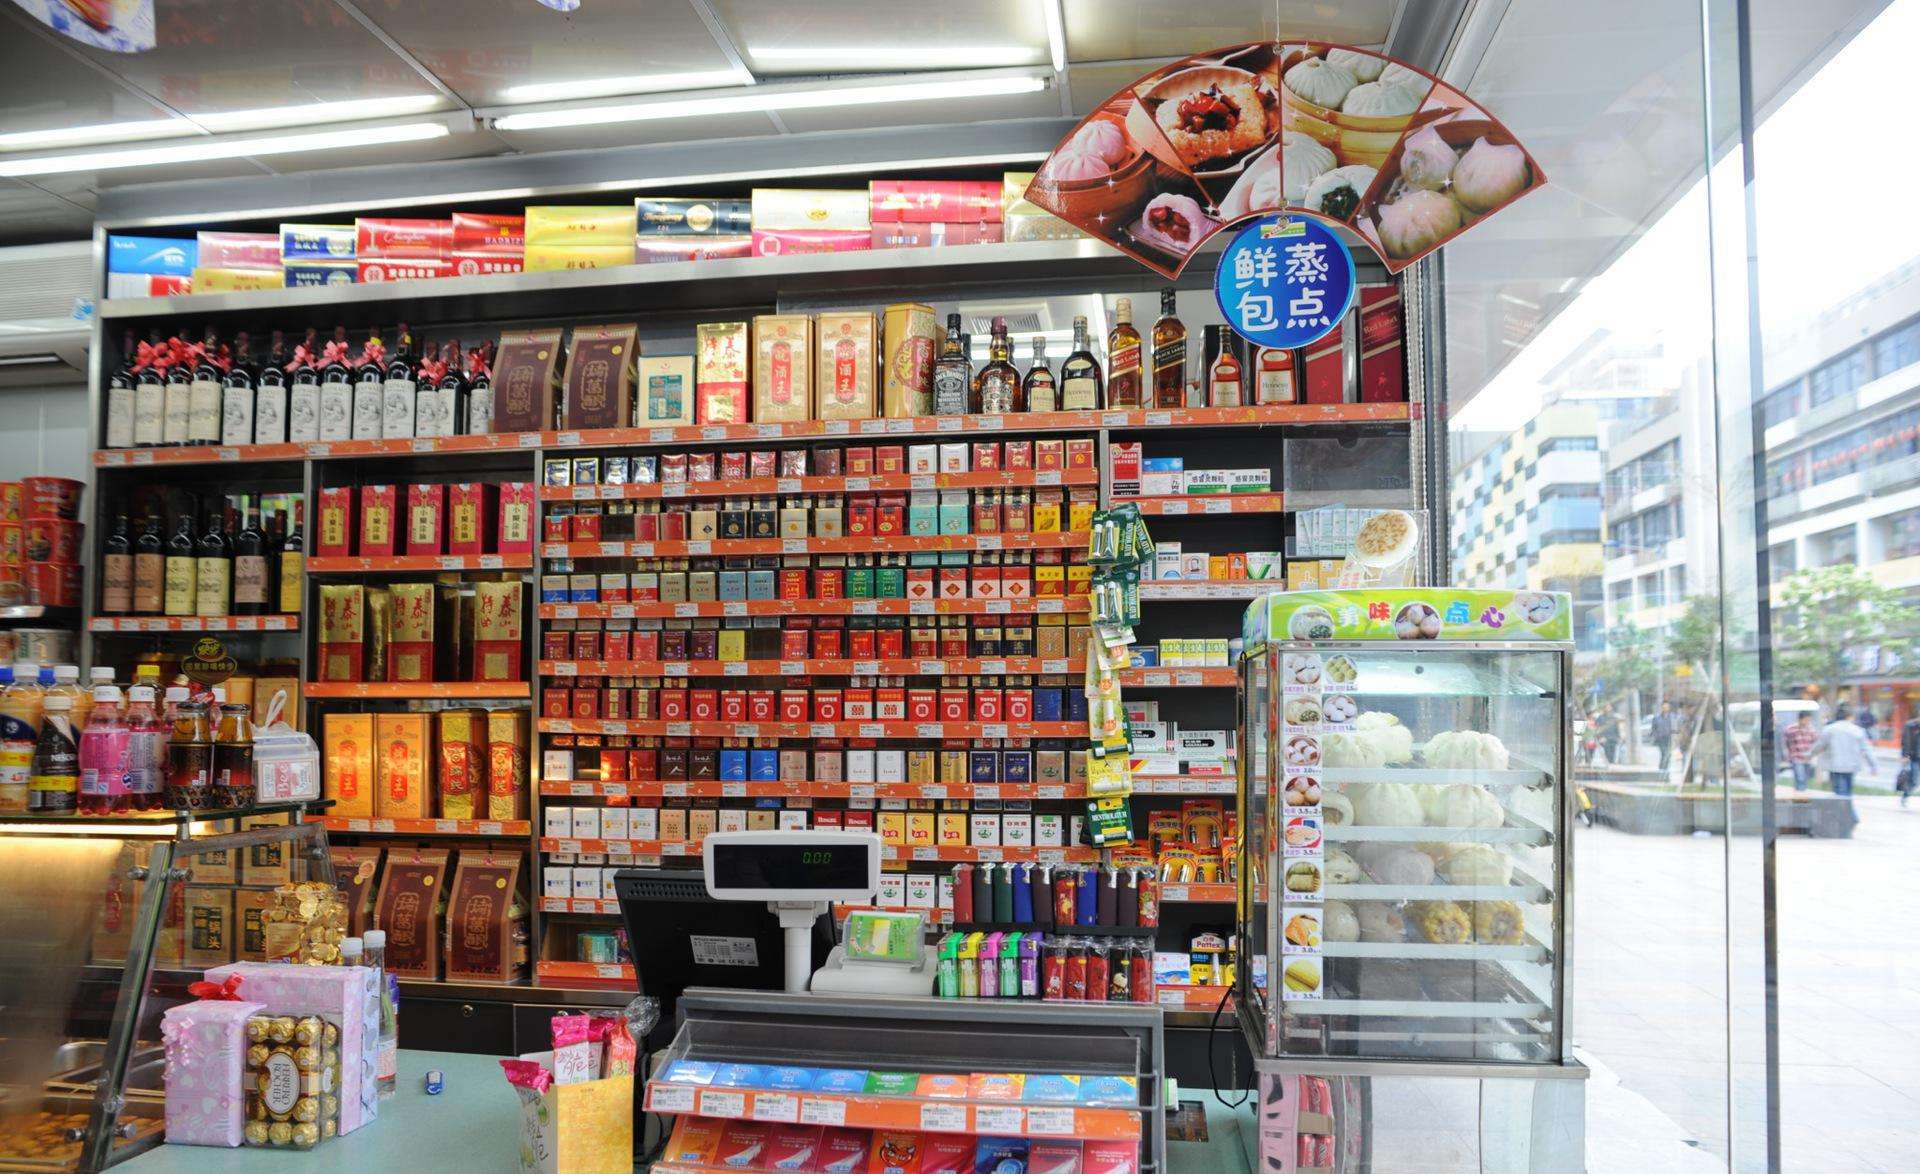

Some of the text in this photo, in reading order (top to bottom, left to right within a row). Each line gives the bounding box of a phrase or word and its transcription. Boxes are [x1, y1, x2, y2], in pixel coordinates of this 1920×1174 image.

[1233, 242, 1329, 289] 鲜蒸
[1236, 287, 1330, 332] 包点
[802, 851, 833, 865] 0.00
